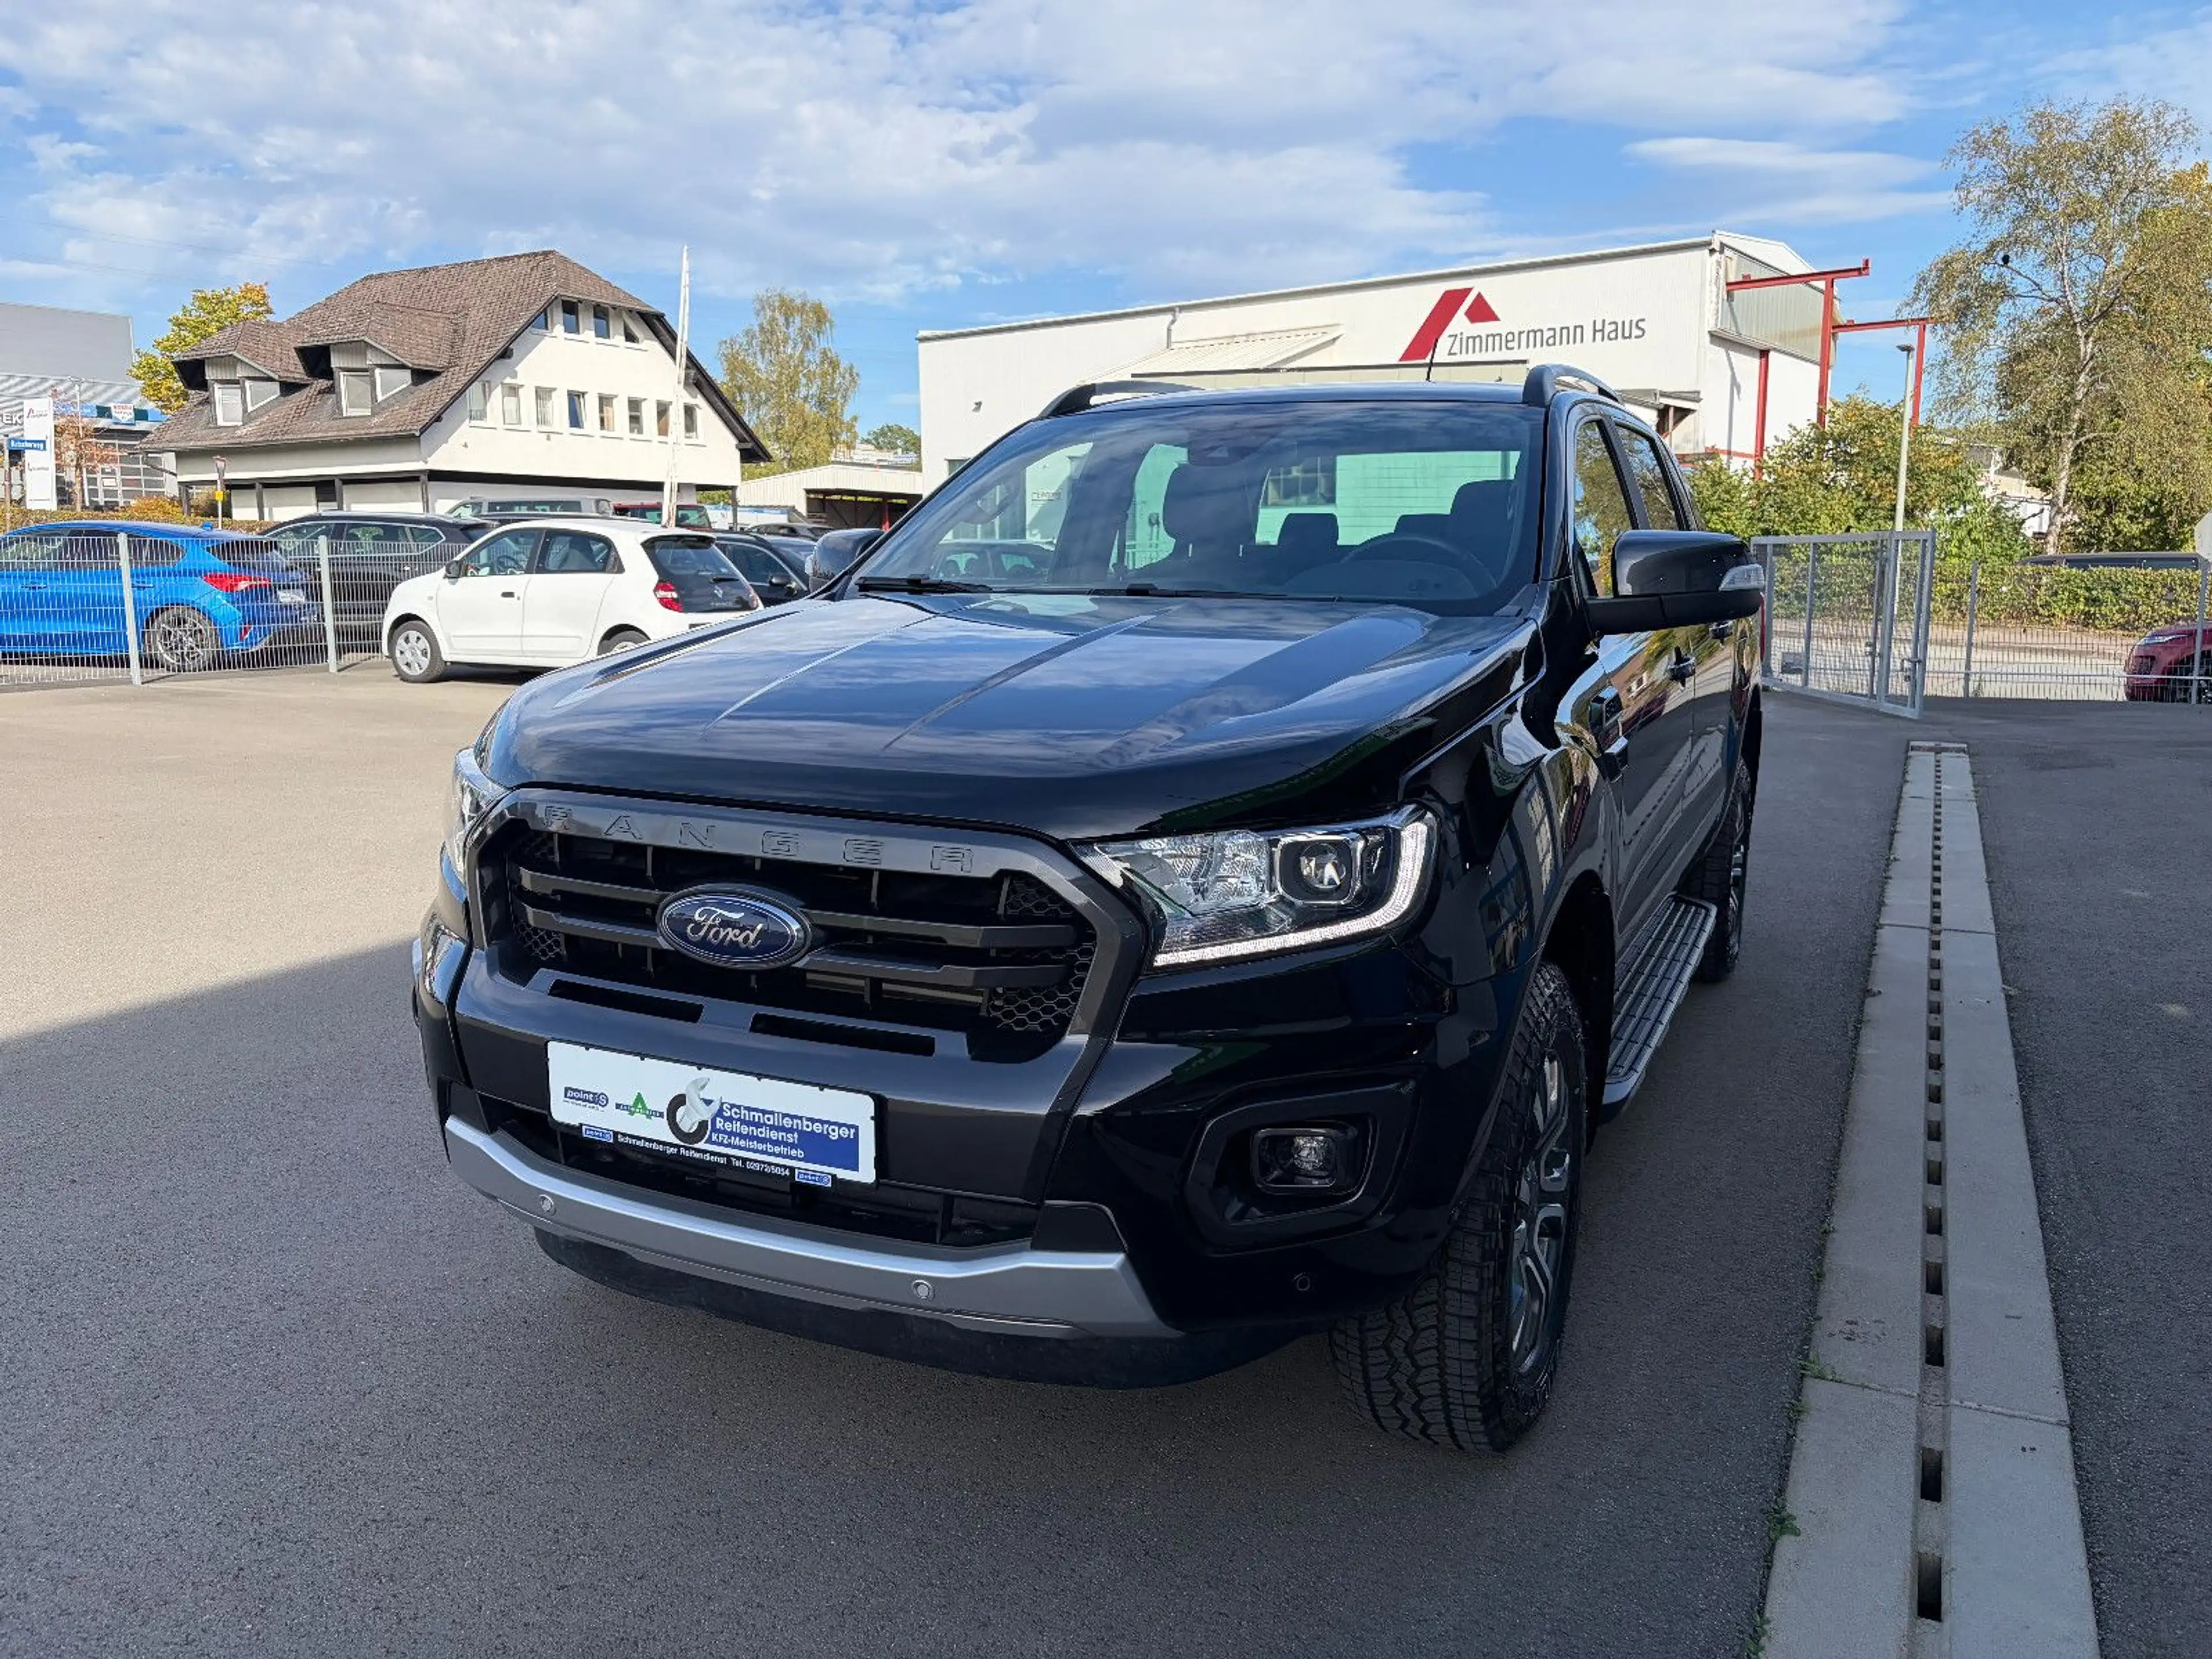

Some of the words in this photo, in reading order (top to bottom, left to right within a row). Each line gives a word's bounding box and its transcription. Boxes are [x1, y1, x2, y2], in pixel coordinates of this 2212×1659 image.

[1447, 324, 1584, 356] Zimmermann
[1592, 318, 1646, 343] Haus
[543, 805, 974, 873] RANGER
[686, 907, 764, 949] Ford
[567, 1089, 594, 1101] point
[715, 1118, 798, 1144] Reifendienst
[722, 1103, 856, 1140] Schmallenberger
[618, 1134, 677, 1154] Schmallenberger
[680, 1147, 727, 1165] Reifendienst
[730, 1157, 745, 1168] Tel.
[711, 1132, 805, 1158] KFZ-Meisterbetrieb
